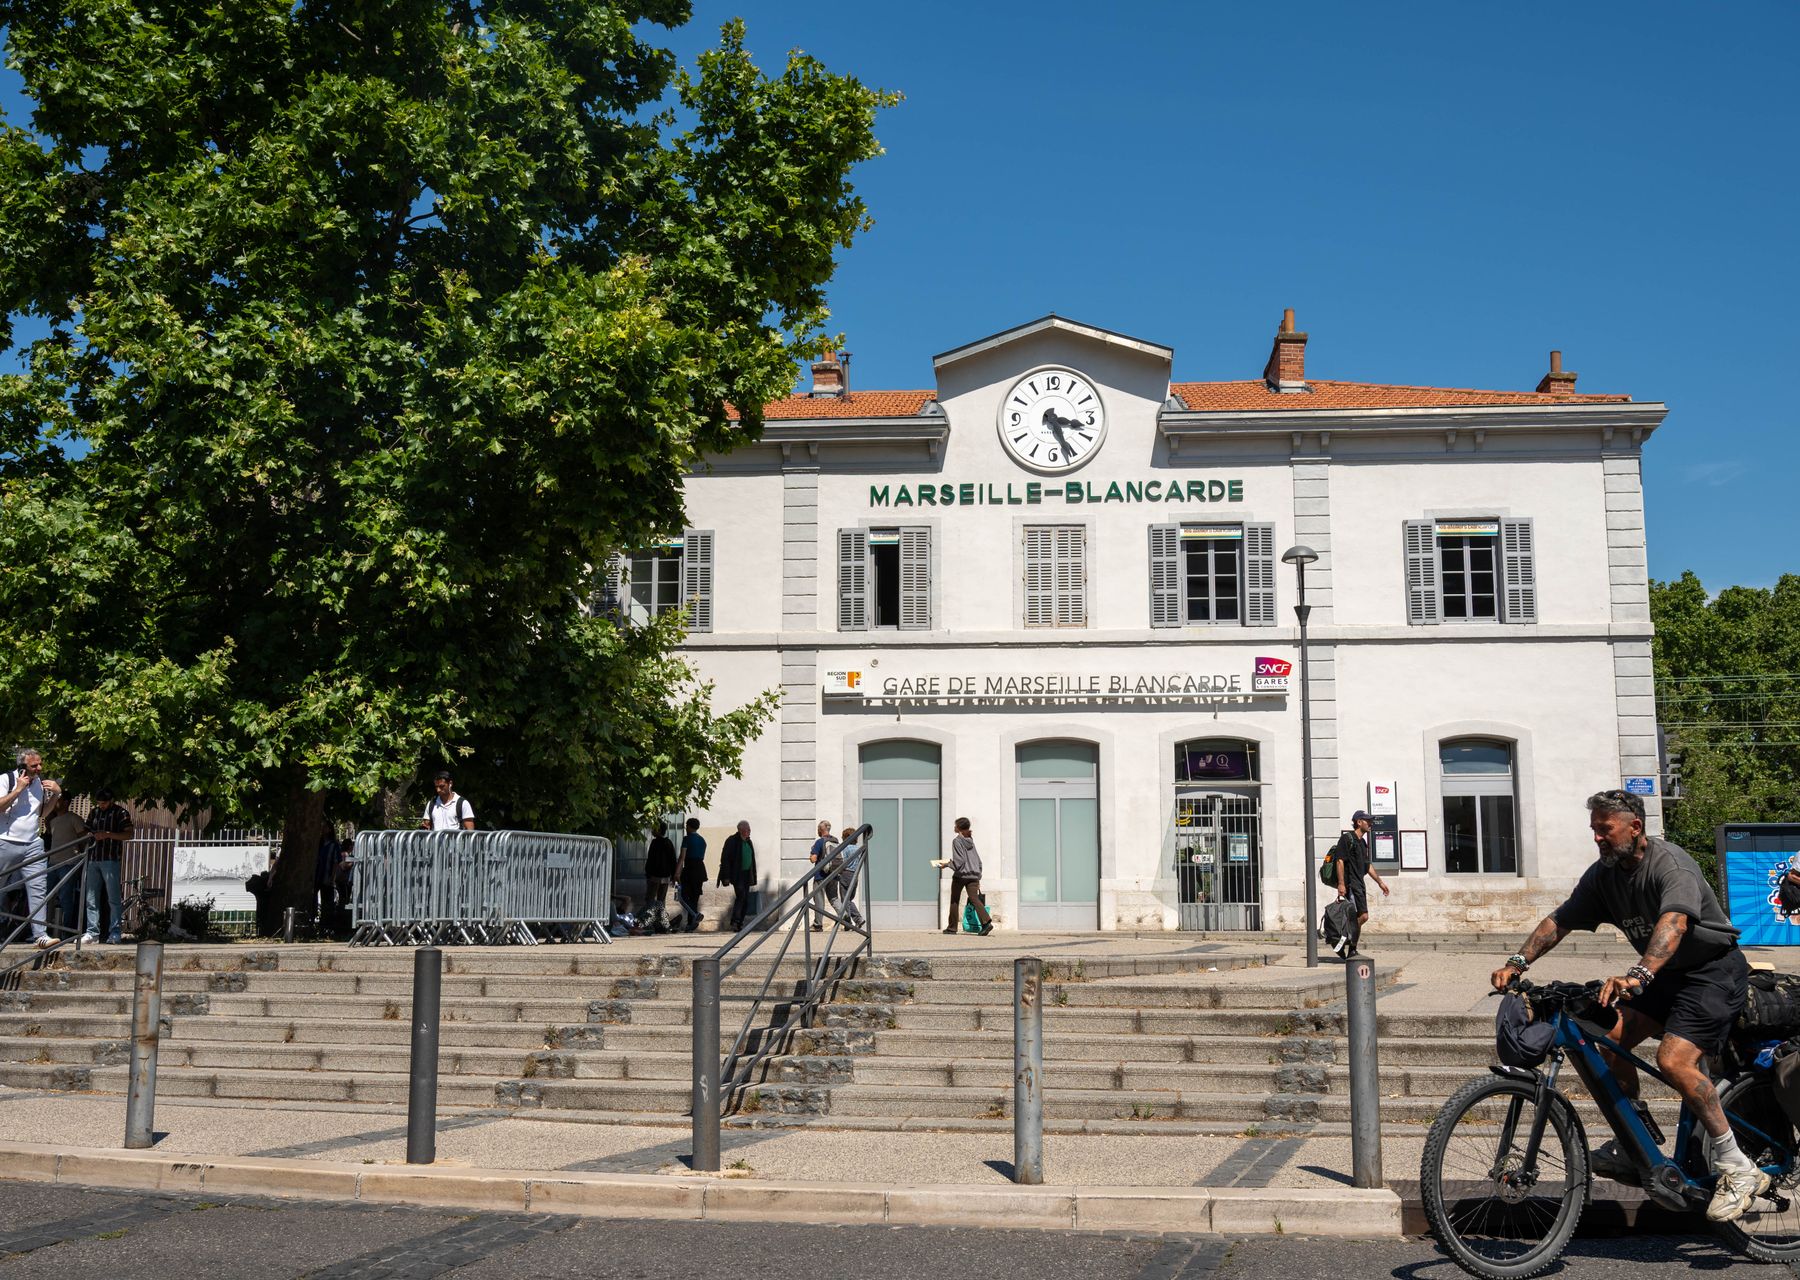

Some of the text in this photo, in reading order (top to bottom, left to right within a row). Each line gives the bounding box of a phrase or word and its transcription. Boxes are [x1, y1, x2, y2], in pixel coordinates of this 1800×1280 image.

[1046, 376, 1060, 391] 12
[1011, 412, 1021, 427] 9
[1085, 410, 1095, 425] 3
[1048, 447, 1058, 462] 6
[1257, 663, 1289, 674] SNCF
[883, 674, 1241, 693] GARE DE MARSEILLE BLANCARDE
